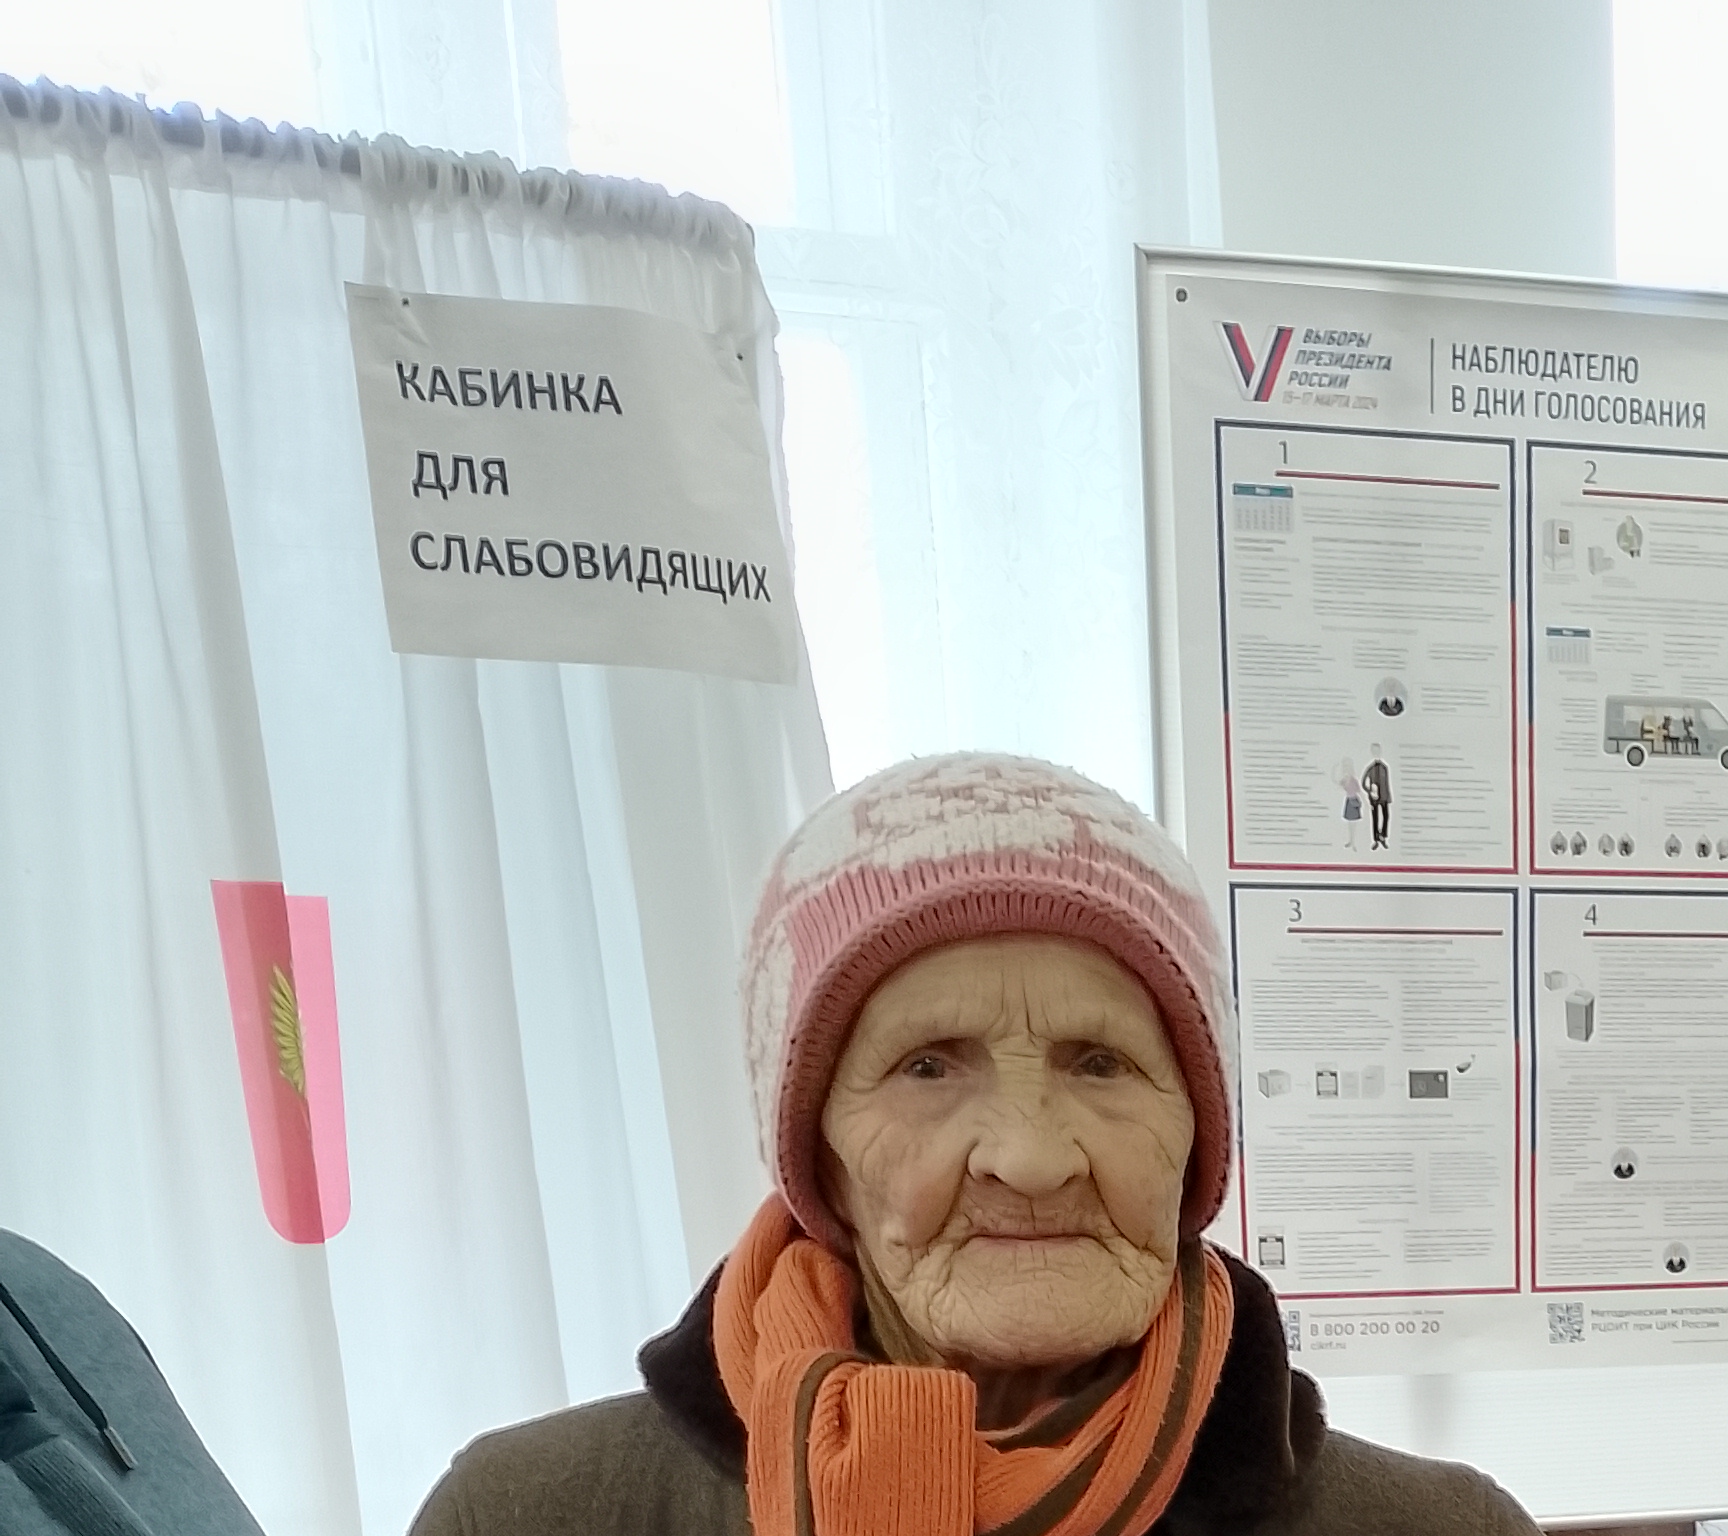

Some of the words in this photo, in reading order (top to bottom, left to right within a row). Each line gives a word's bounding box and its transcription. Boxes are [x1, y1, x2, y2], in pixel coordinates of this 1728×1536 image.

[1302, 328, 1373, 349] ВЫБОРЫ
[1294, 349, 1392, 372] ПРЕЗИДЕНТА
[1451, 342, 1639, 384] НАБЛЮДАТЕЛЮ
[395, 359, 624, 416] КАБИНКА
[1287, 370, 1350, 389] РОССИИ
[1451, 385, 1466, 414] В
[1473, 387, 1525, 419] ДНИ
[1534, 389, 1707, 430] ГОЛОСОВАНИЯ
[1277, 440, 1288, 465] 1
[411, 449, 510, 501] ДЛЯ
[1583, 460, 1597, 485] 2
[409, 531, 773, 605] СЛАБОВИДЯЩИХ
[1288, 898, 1303, 923] 3
[1583, 903, 1599, 926] 4
[1324, 1322, 1355, 1336] 800
[1360, 1322, 1390, 1335] 200
[1395, 1321, 1416, 1334] 00
[1421, 1320, 1440, 1334] 20
